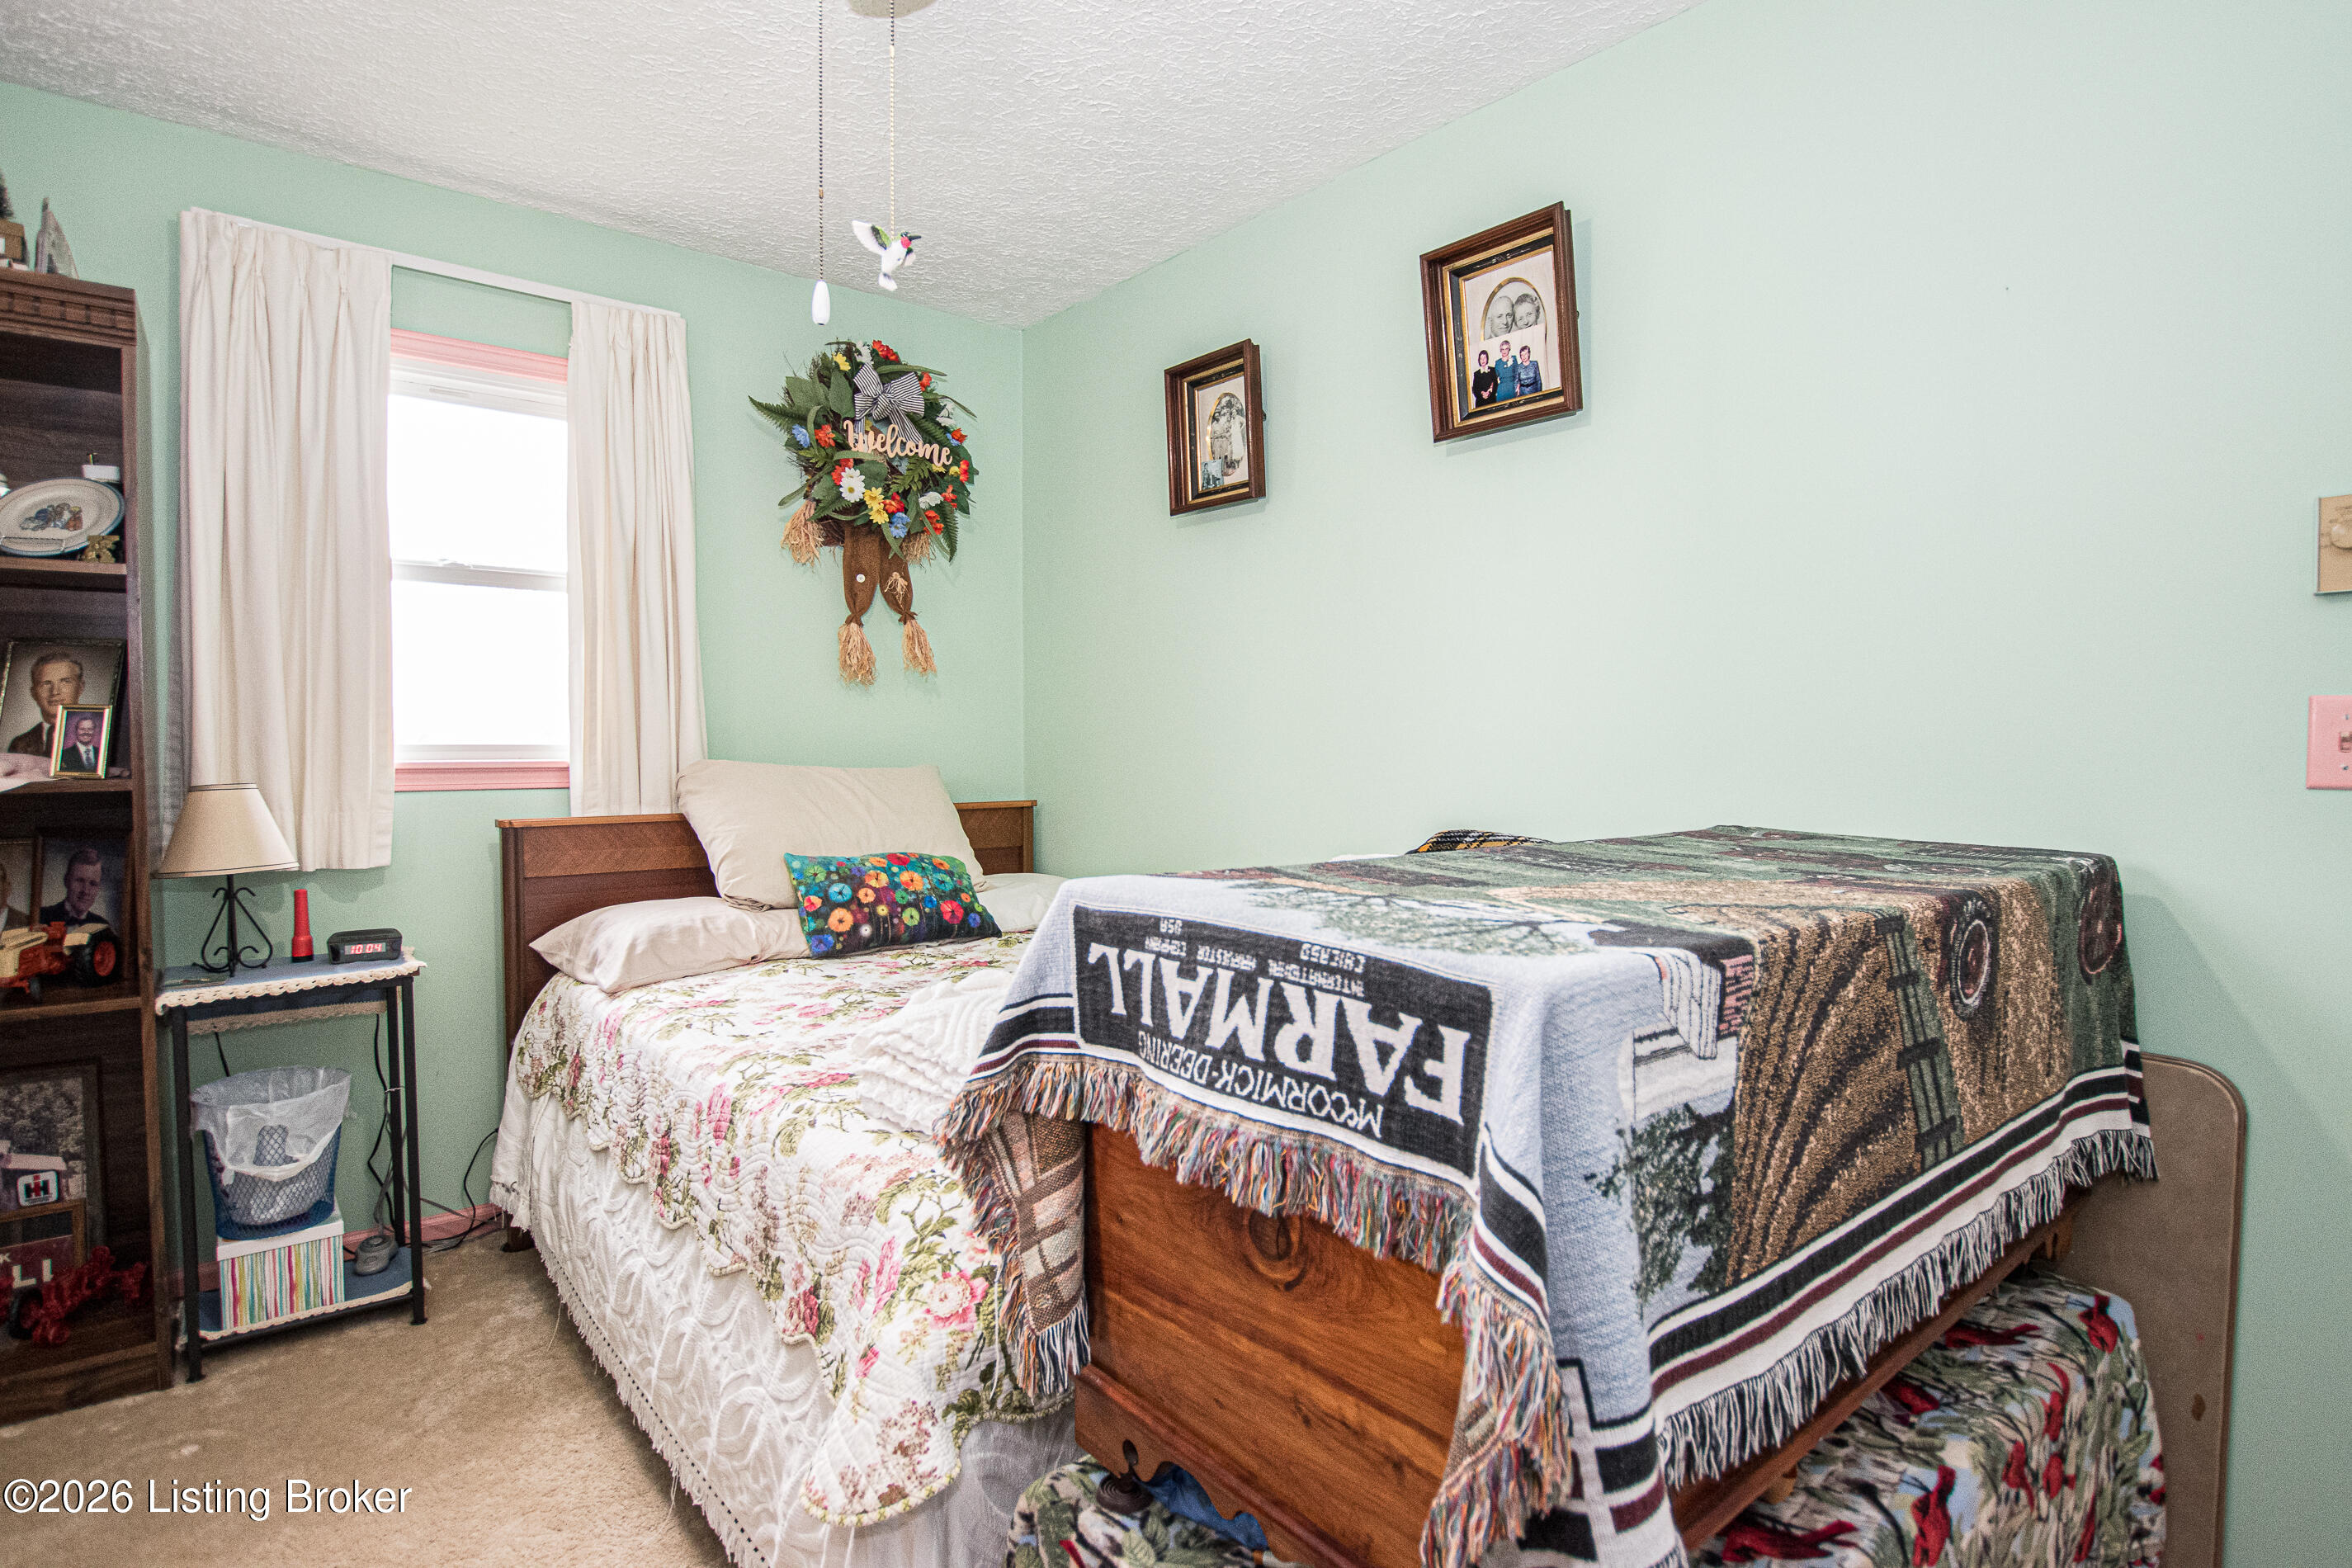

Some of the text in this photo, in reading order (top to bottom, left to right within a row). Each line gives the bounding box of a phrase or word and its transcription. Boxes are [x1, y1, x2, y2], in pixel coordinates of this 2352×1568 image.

[843, 419, 953, 467] Welcome
[1159, 917, 1366, 974] CHICAGO USA
[1087, 942, 1471, 1126] FARMALL
